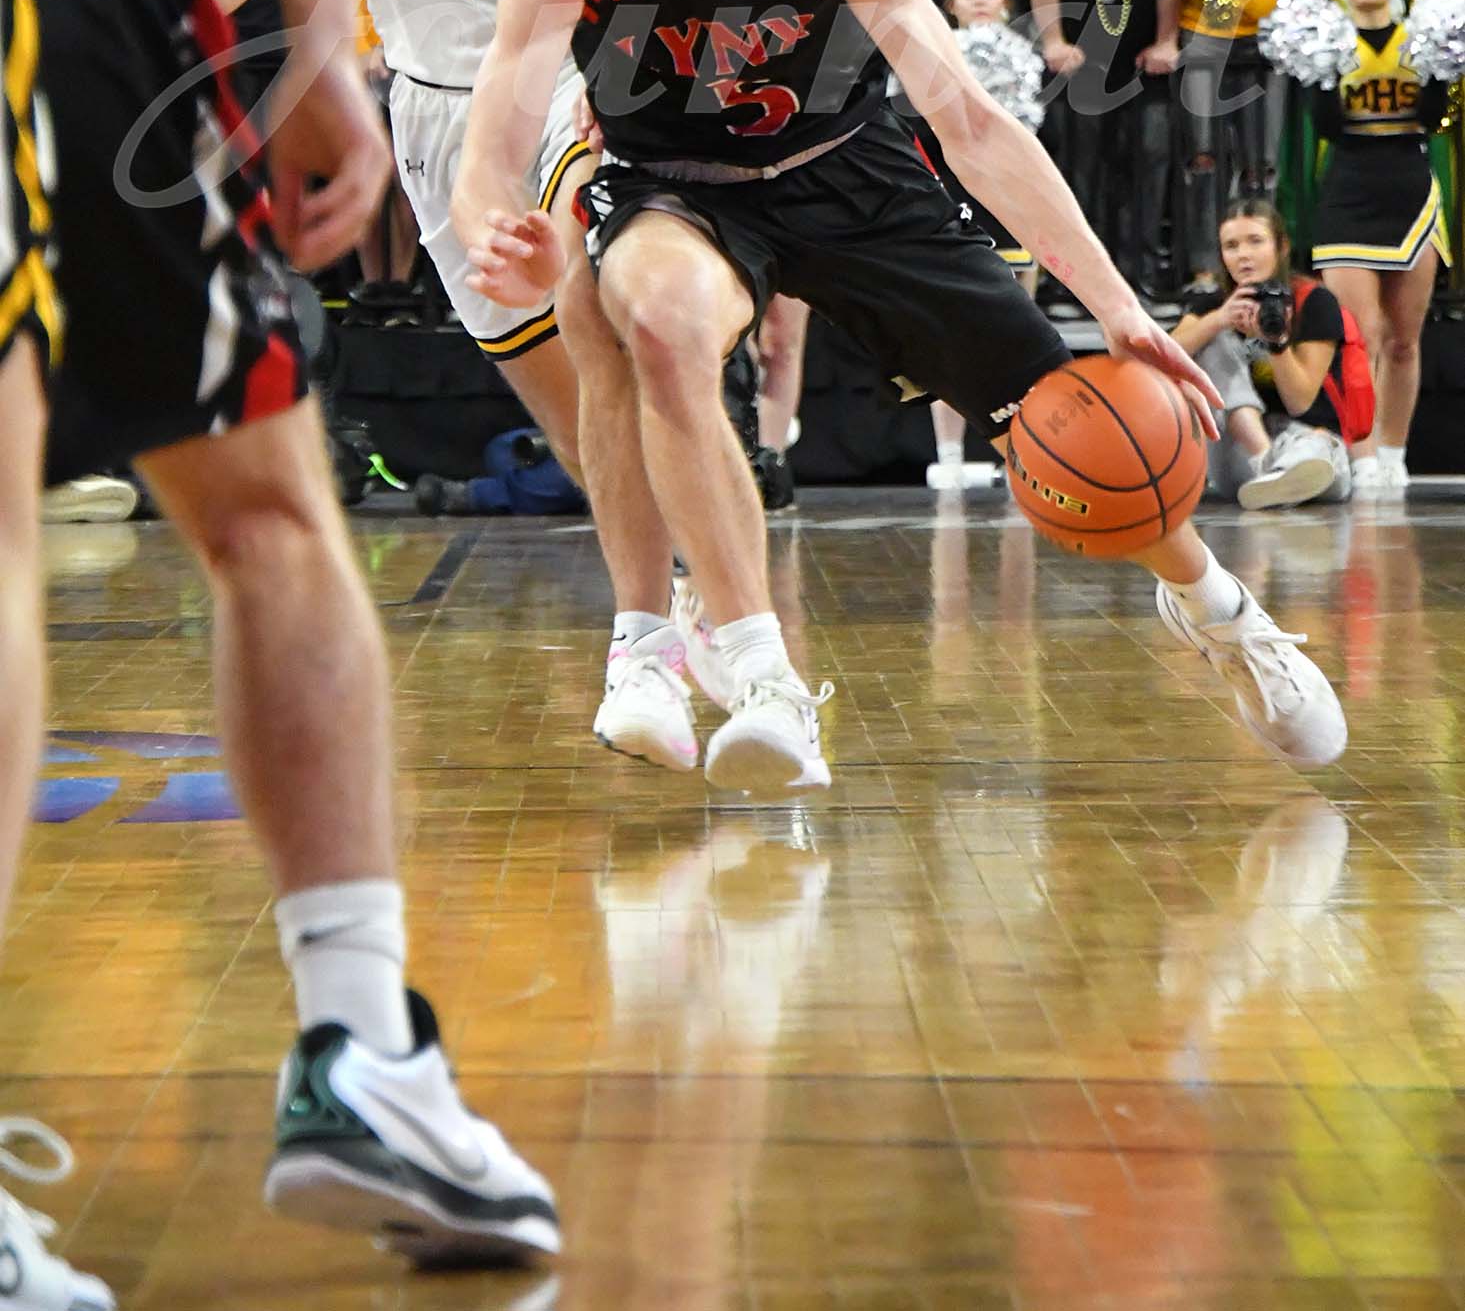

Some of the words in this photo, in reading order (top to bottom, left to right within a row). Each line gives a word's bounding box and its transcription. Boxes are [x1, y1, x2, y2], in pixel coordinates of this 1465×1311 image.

[615, 13, 815, 77] YNX
[703, 78, 800, 137] 5
[1344, 77, 1420, 112] MHS
